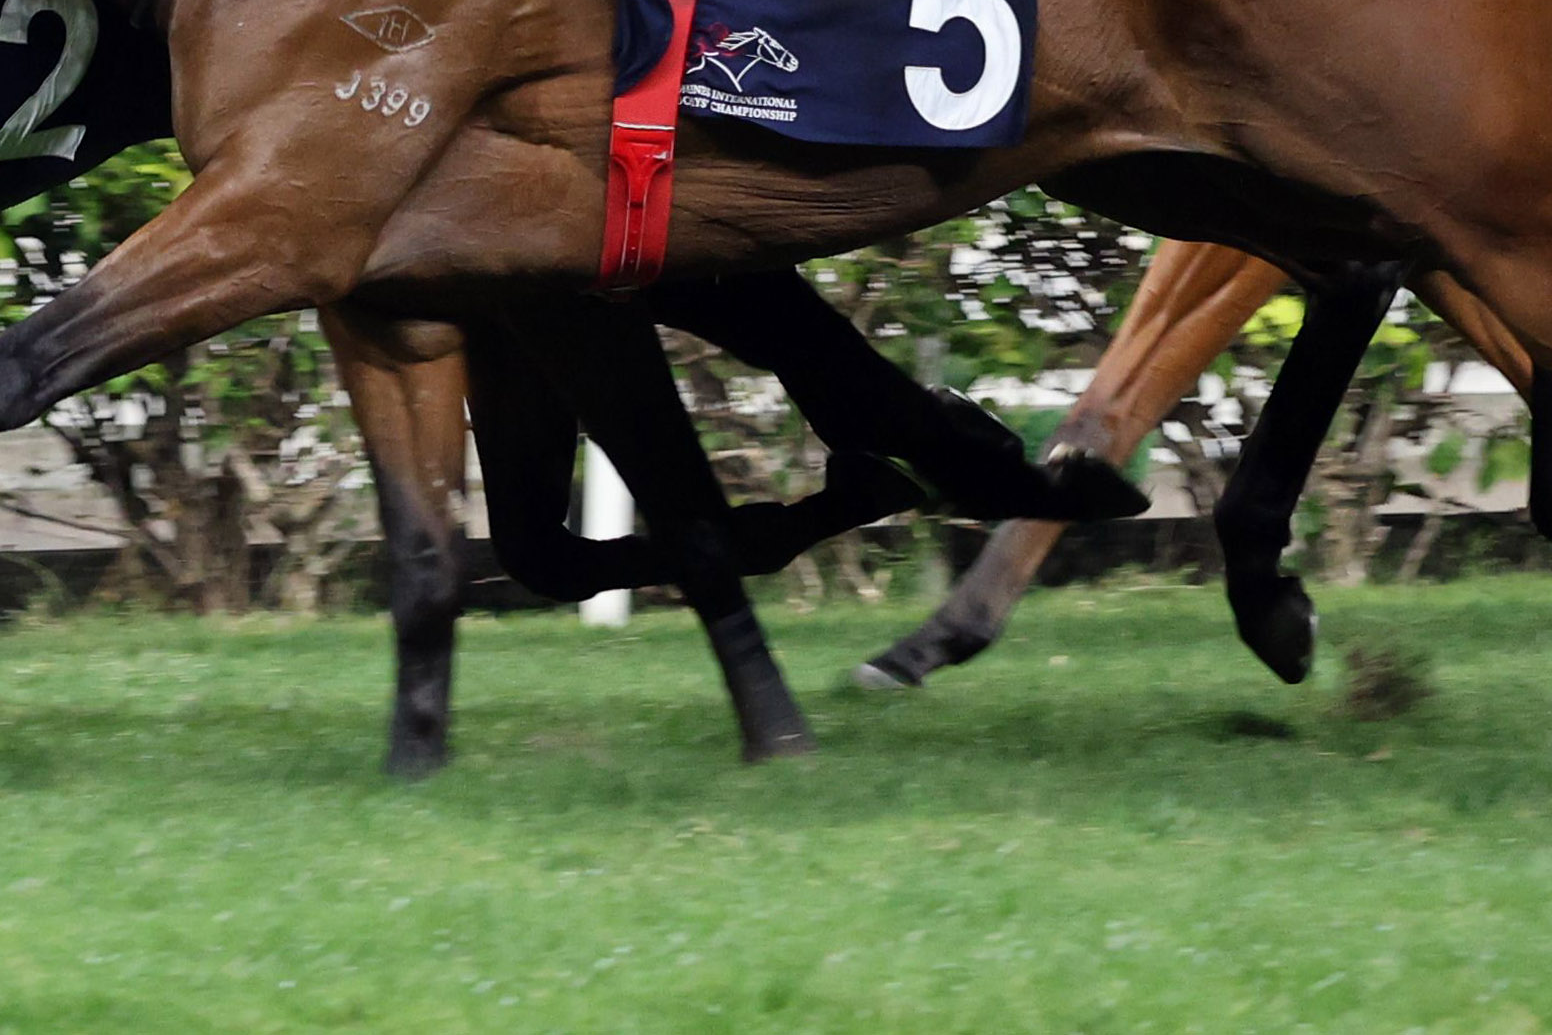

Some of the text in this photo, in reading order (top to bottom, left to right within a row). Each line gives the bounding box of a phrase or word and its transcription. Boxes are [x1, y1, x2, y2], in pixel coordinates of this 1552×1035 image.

[335, 70, 431, 127] J399
[711, 89, 798, 110] INTERNATIONAL
[710, 101, 798, 122] CHAMPIONSHIP
